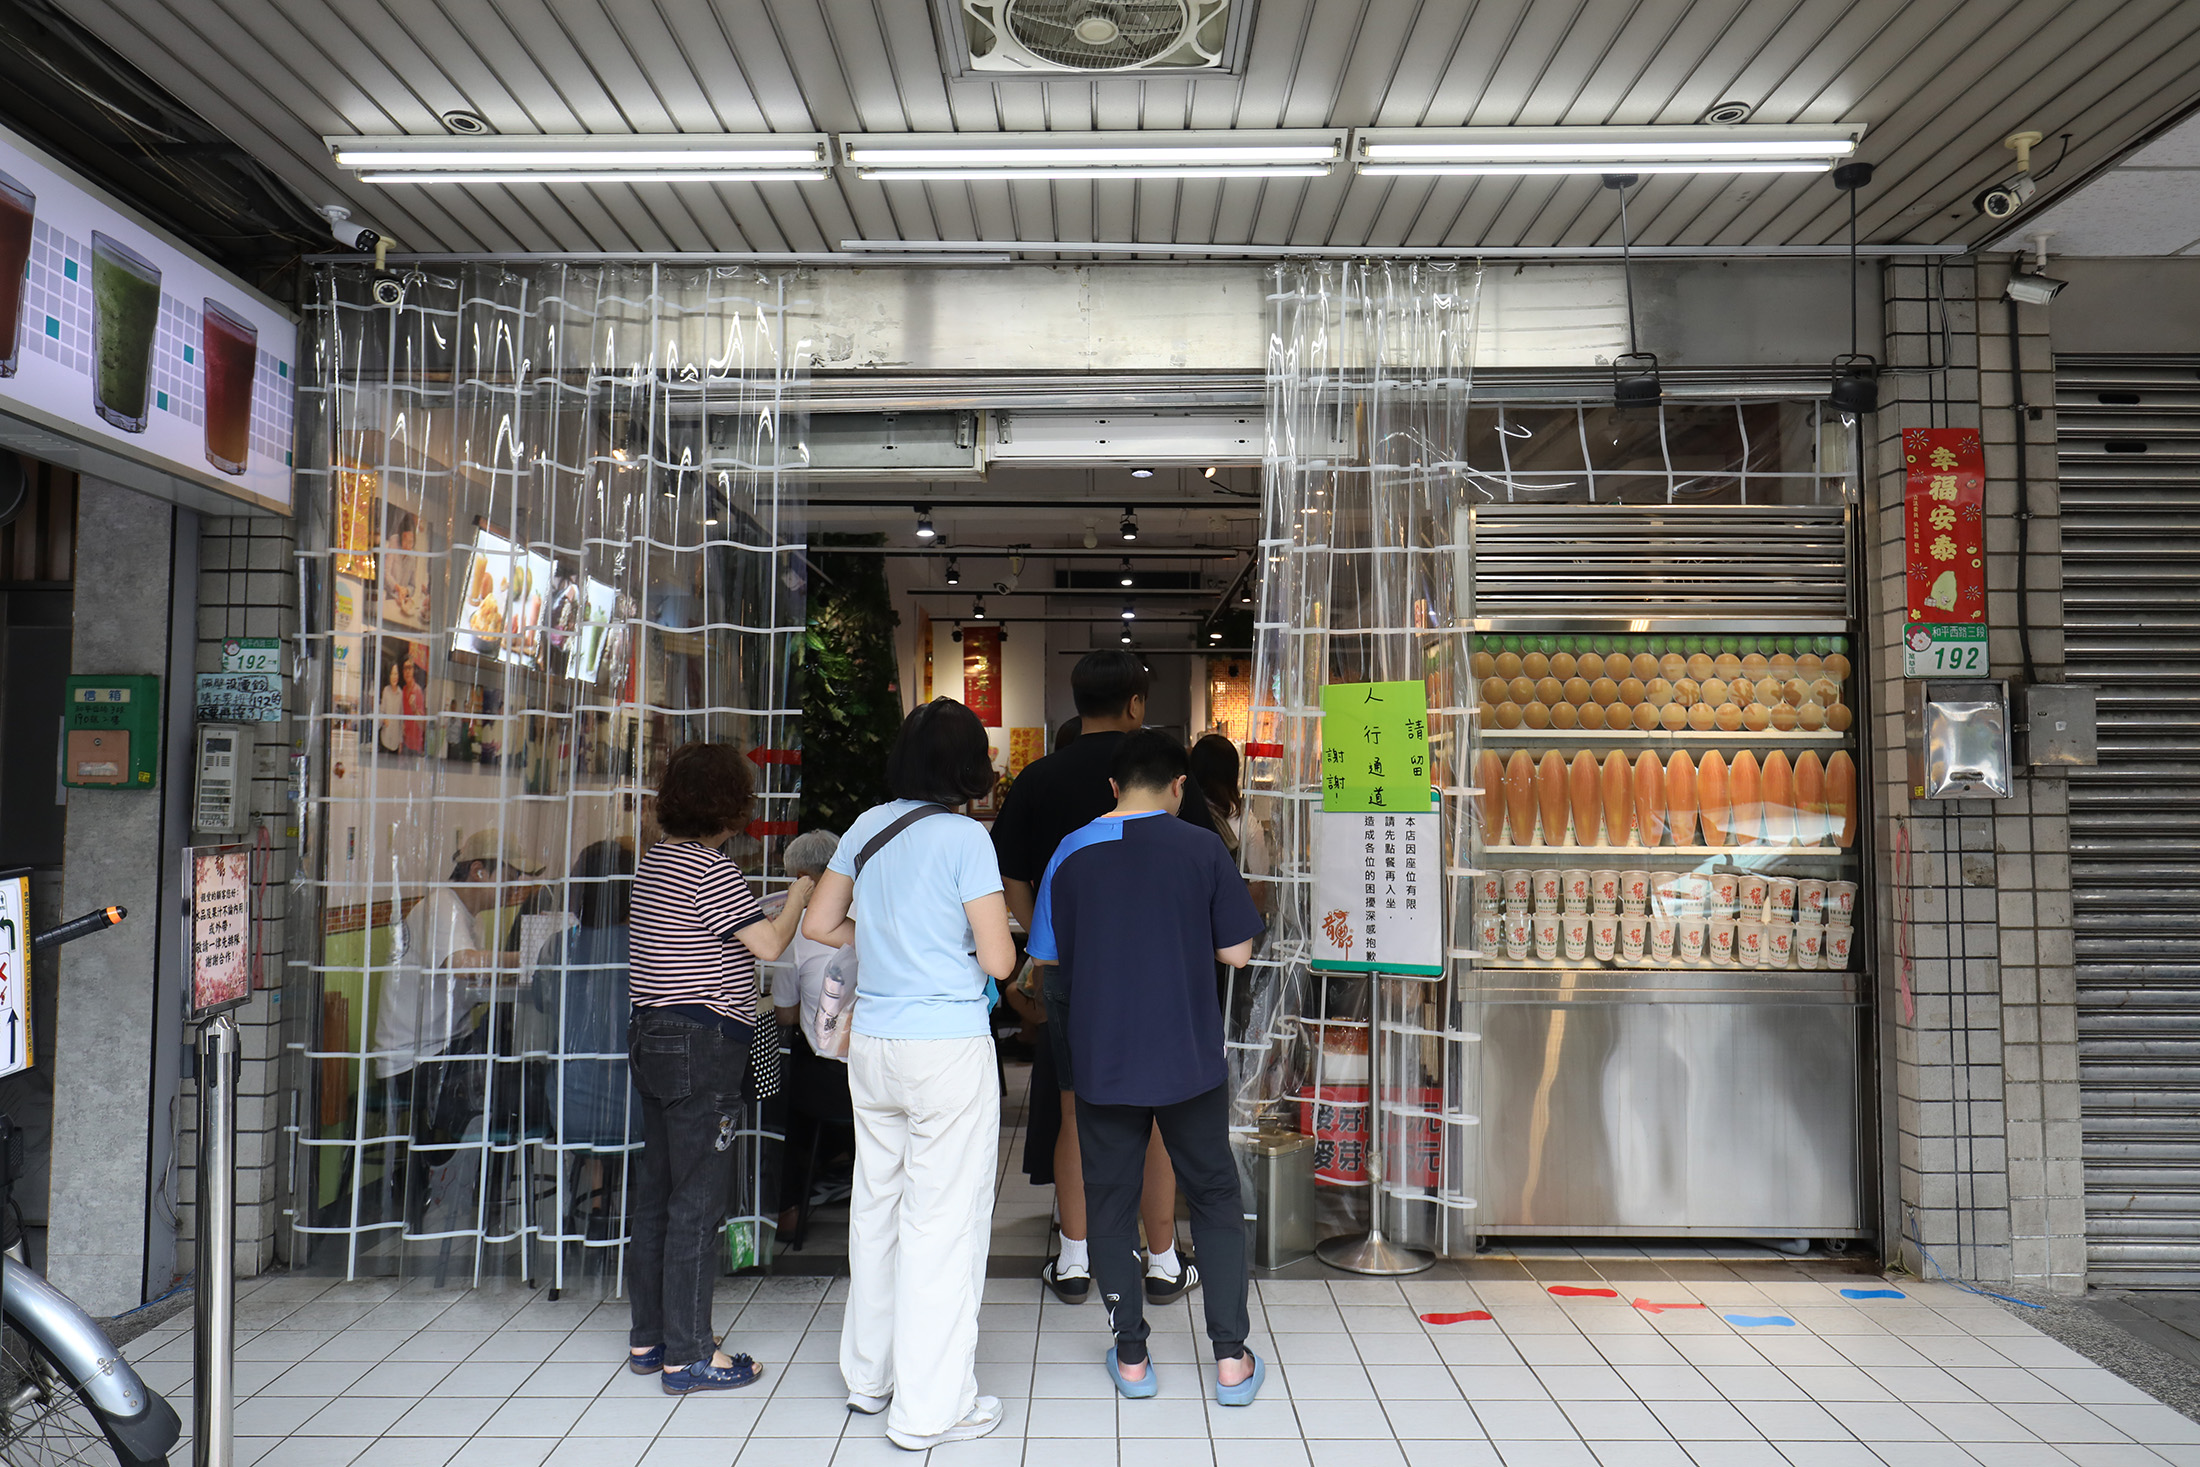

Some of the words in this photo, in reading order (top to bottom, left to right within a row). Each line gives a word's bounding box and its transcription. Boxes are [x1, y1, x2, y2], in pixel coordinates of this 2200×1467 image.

[1929, 445, 1959, 562] 幸福安泰
[1932, 625, 1985, 638] 和平西路三段
[237, 655, 266, 670] 192
[1935, 647, 1979, 670] 192
[83, 690, 122, 702] 信箱
[1363, 686, 1388, 808] 人行通道
[1363, 815, 1377, 962] 造成各位的困擾深感抱歉
